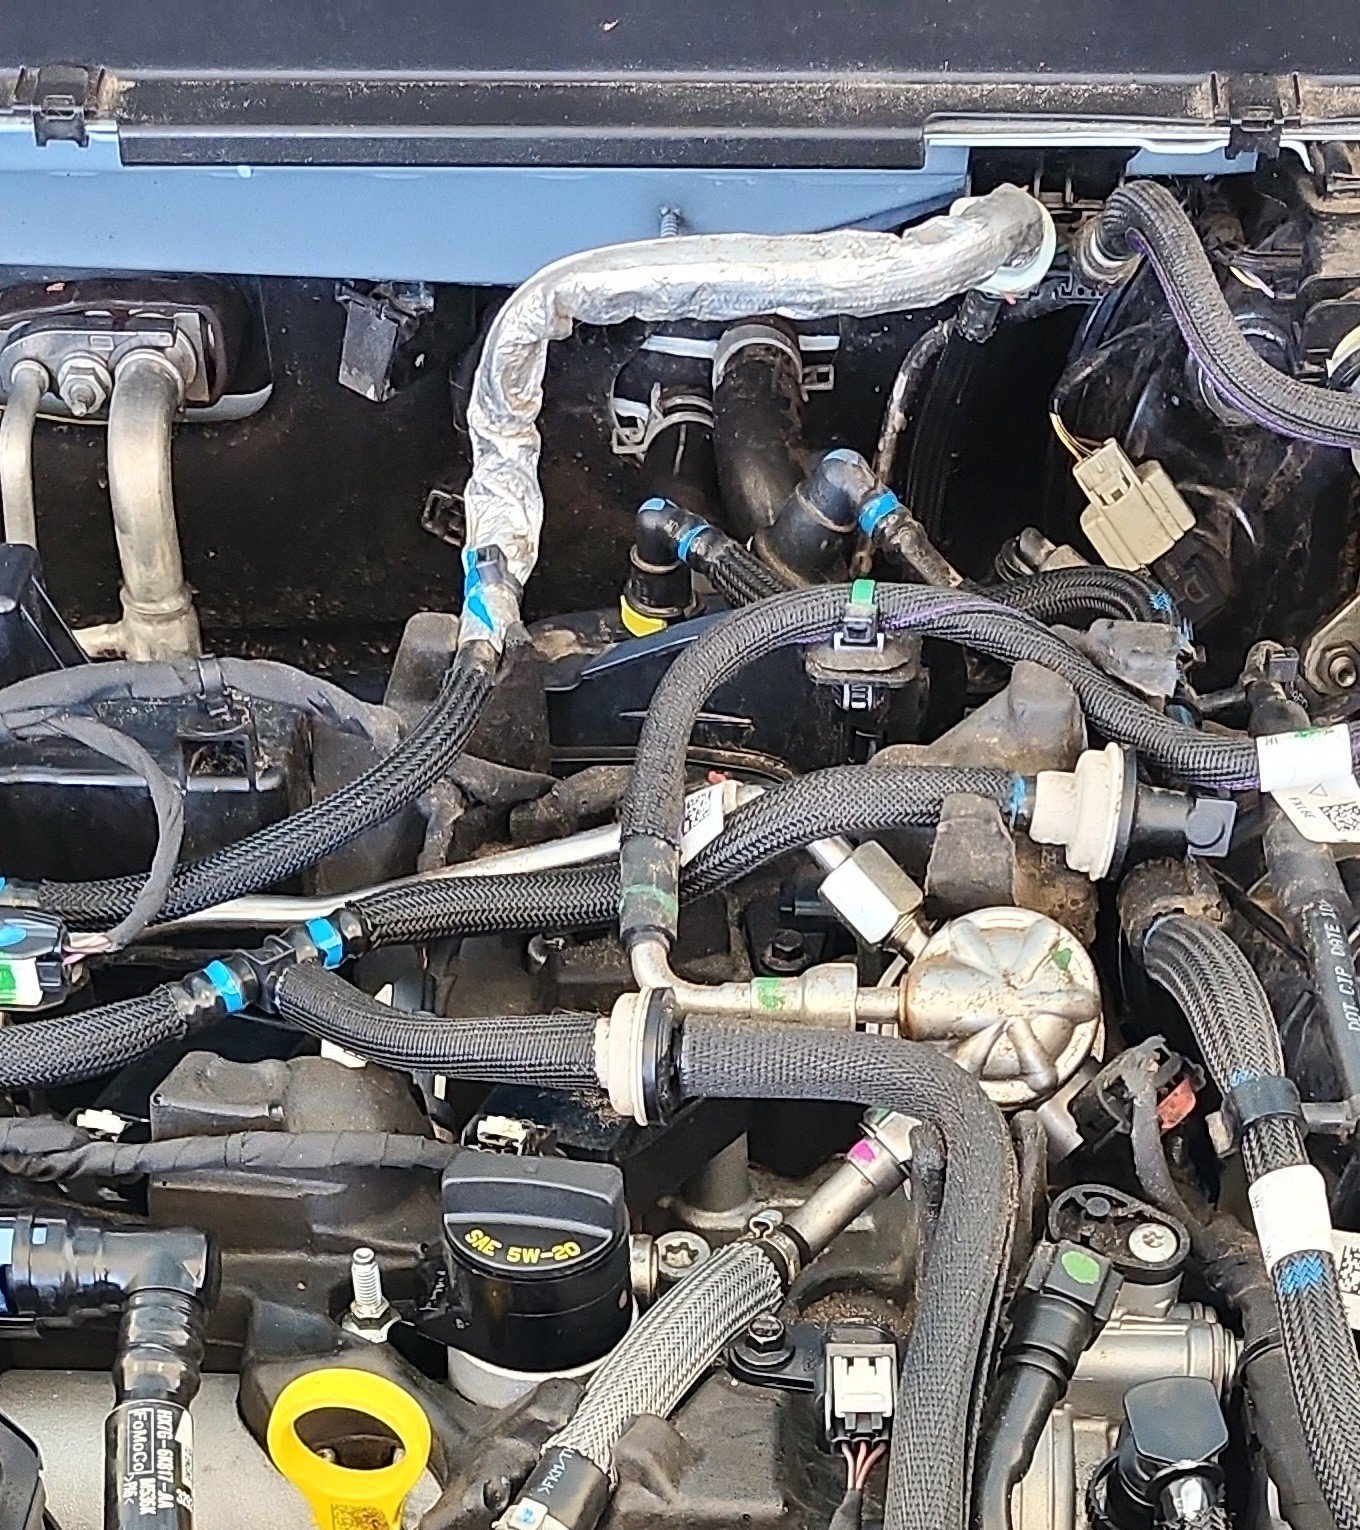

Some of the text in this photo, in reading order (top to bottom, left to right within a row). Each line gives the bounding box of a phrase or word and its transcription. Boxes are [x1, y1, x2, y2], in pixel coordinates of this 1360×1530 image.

[1323, 919, 1346, 959] DATE
[1333, 962, 1355, 998] CIP
[463, 1228, 580, 1266] SAE 5W-20
[131, 1411, 148, 1471] FoMoCo
